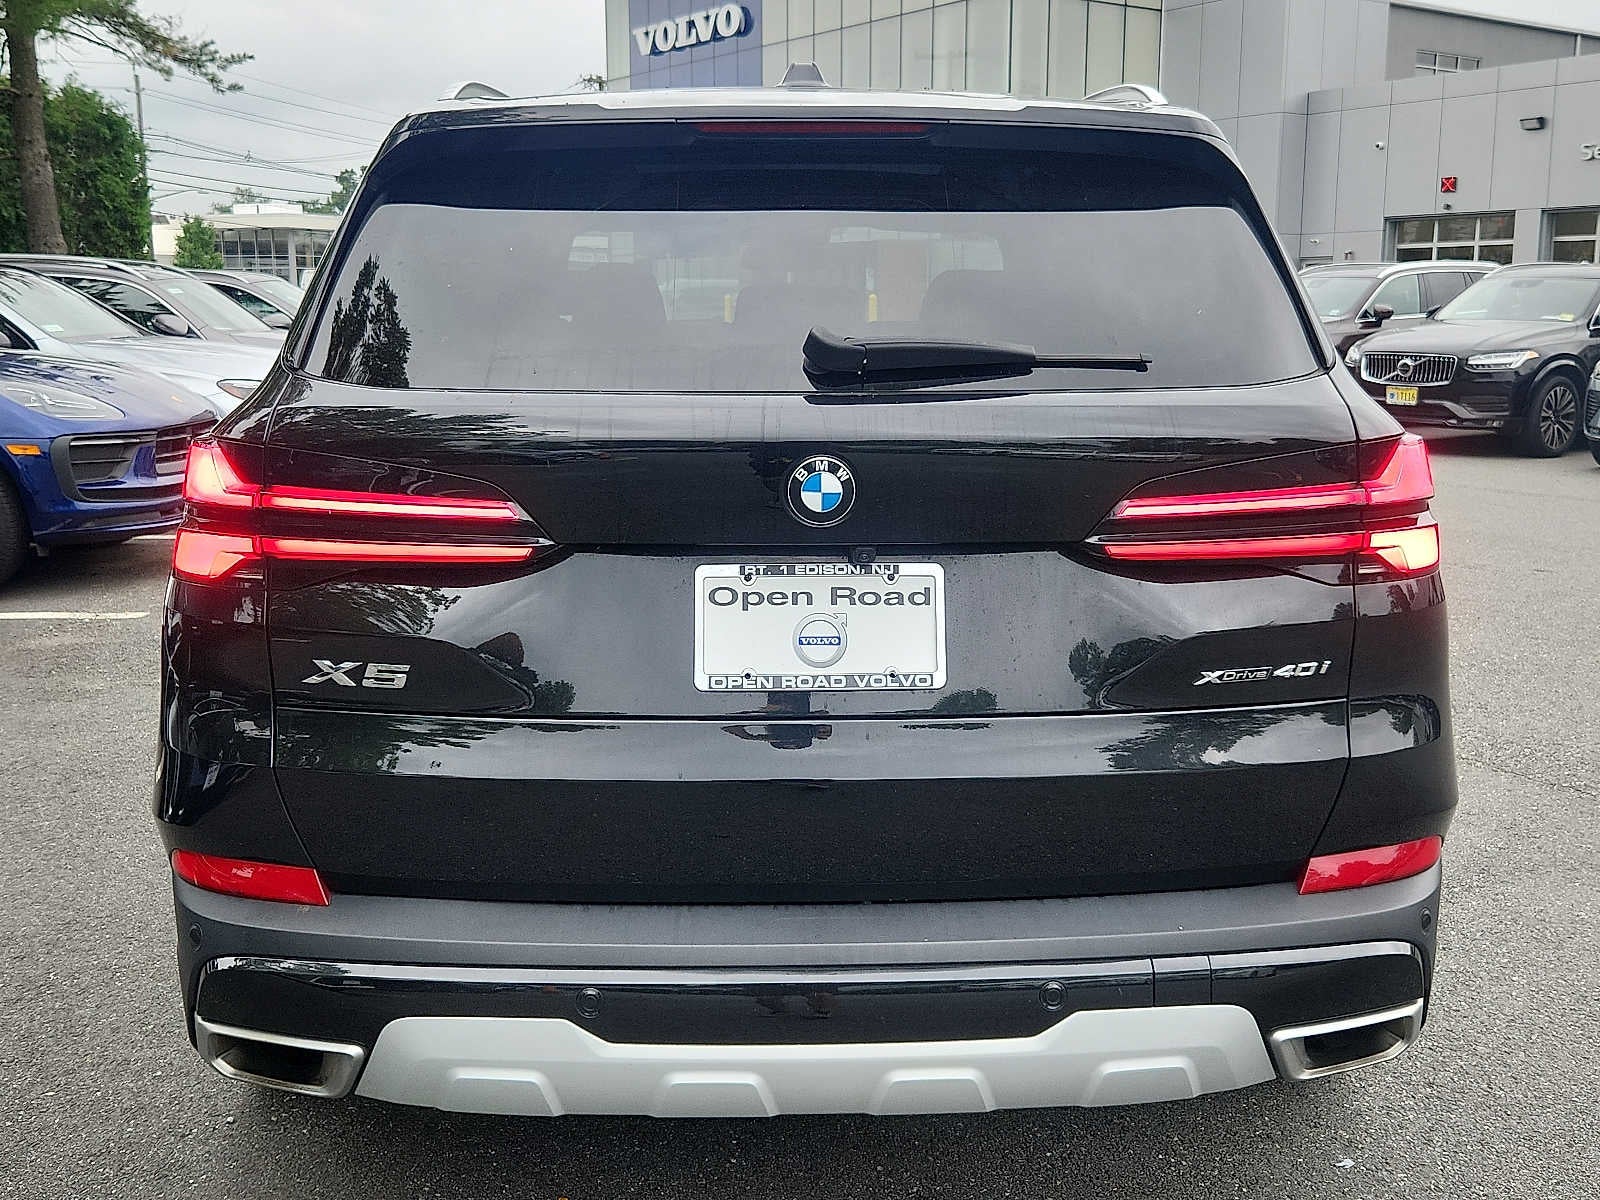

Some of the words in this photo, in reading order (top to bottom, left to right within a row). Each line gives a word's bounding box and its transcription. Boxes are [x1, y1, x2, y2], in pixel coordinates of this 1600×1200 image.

[633, 3, 743, 56] VOLVO
[794, 460, 850, 482] BMW
[779, 565, 788, 575] 1
[871, 564, 895, 575] NJ
[708, 586, 814, 611] Open
[830, 586, 931, 607] Road
[800, 637, 840, 645] VOLVO
[301, 659, 411, 689] X5
[710, 675, 774, 689] OPEN
[783, 675, 848, 689] ROAD
[854, 674, 933, 688] VOLVO
